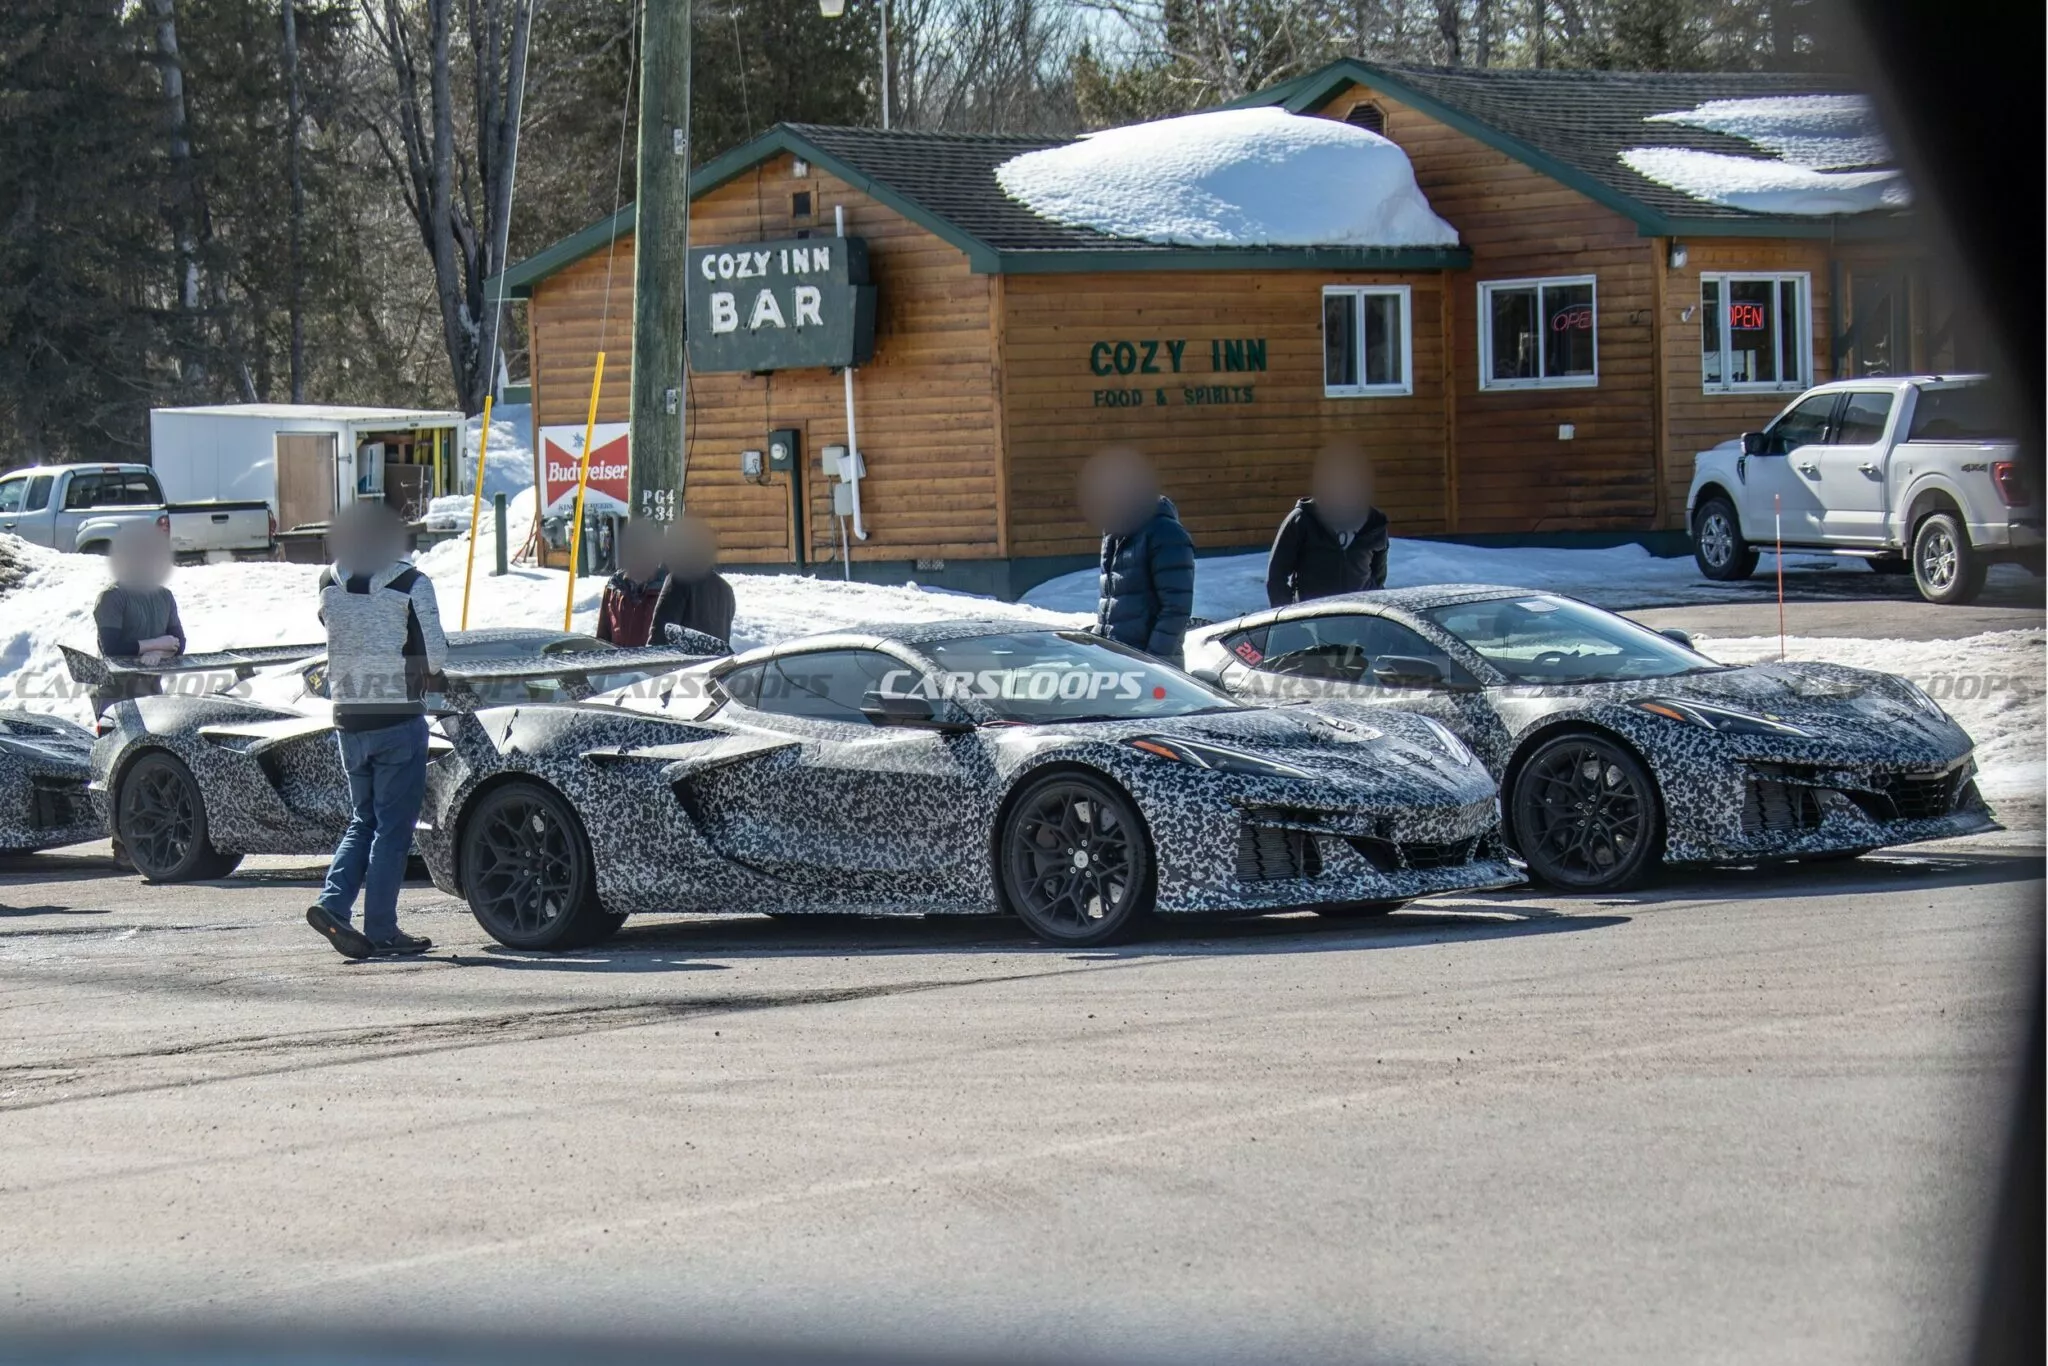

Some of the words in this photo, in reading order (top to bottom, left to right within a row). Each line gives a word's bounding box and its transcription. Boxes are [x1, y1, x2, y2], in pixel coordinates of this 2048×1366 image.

[702, 251, 771, 280] COZY
[780, 247, 830, 274] INN
[711, 286, 823, 334] BAR
[1553, 311, 1592, 330] OPE
[1090, 340, 1186, 376] COZY
[1212, 338, 1267, 372] INN
[1094, 389, 1142, 407] FOOD
[1156, 388, 1167, 406] &
[1184, 385, 1255, 405] SPIRITS
[548, 460, 628, 482] Budeiser
[642, 489, 675, 505] PG4
[642, 506, 674, 520] 234
[1235, 641, 1264, 667] 20
